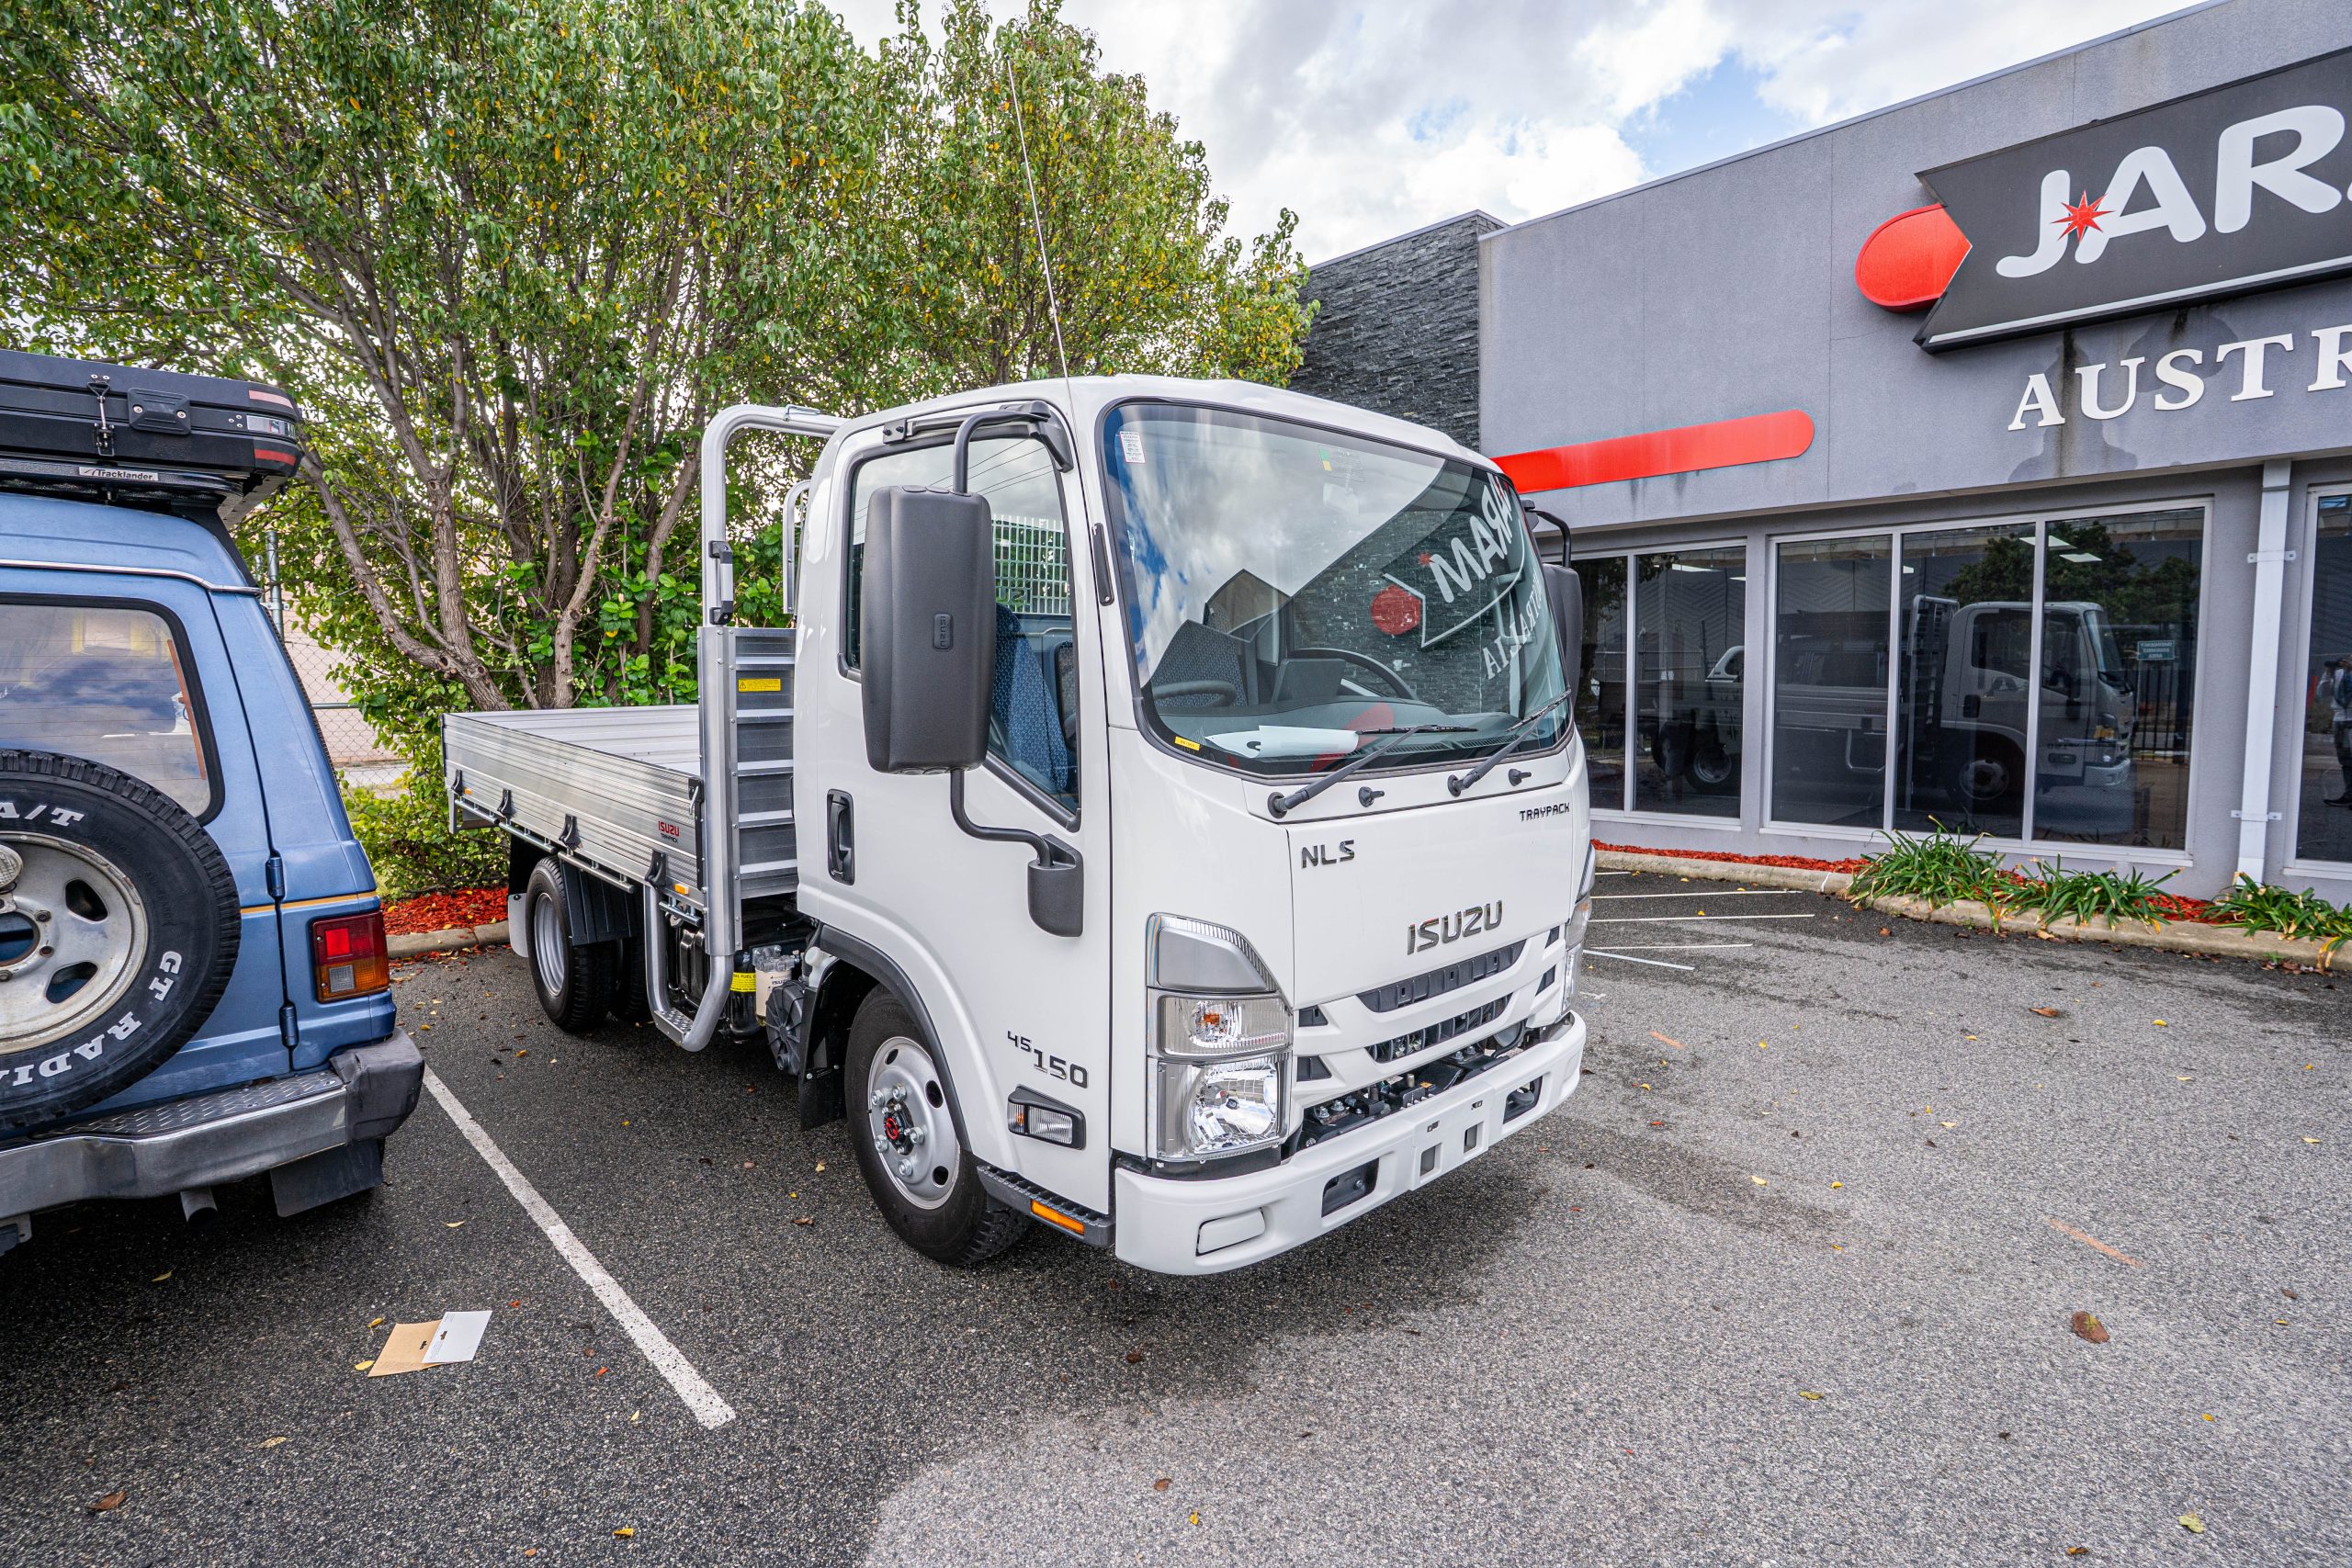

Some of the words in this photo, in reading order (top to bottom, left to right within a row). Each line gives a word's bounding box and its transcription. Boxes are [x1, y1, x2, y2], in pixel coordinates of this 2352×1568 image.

[1996, 105, 2352, 278] JAR
[95, 468, 153, 480] Tracklander
[658, 820, 680, 837] ISUZU
[1519, 802, 1570, 821] TRAYPACK
[1301, 840, 1355, 869] NLS
[1407, 899, 1503, 956] ISUZU
[149, 951, 183, 1002] GT
[0, 1011, 142, 1087] RADI
[1007, 1030, 1032, 1053] 45
[1034, 1048, 1088, 1089] 150
